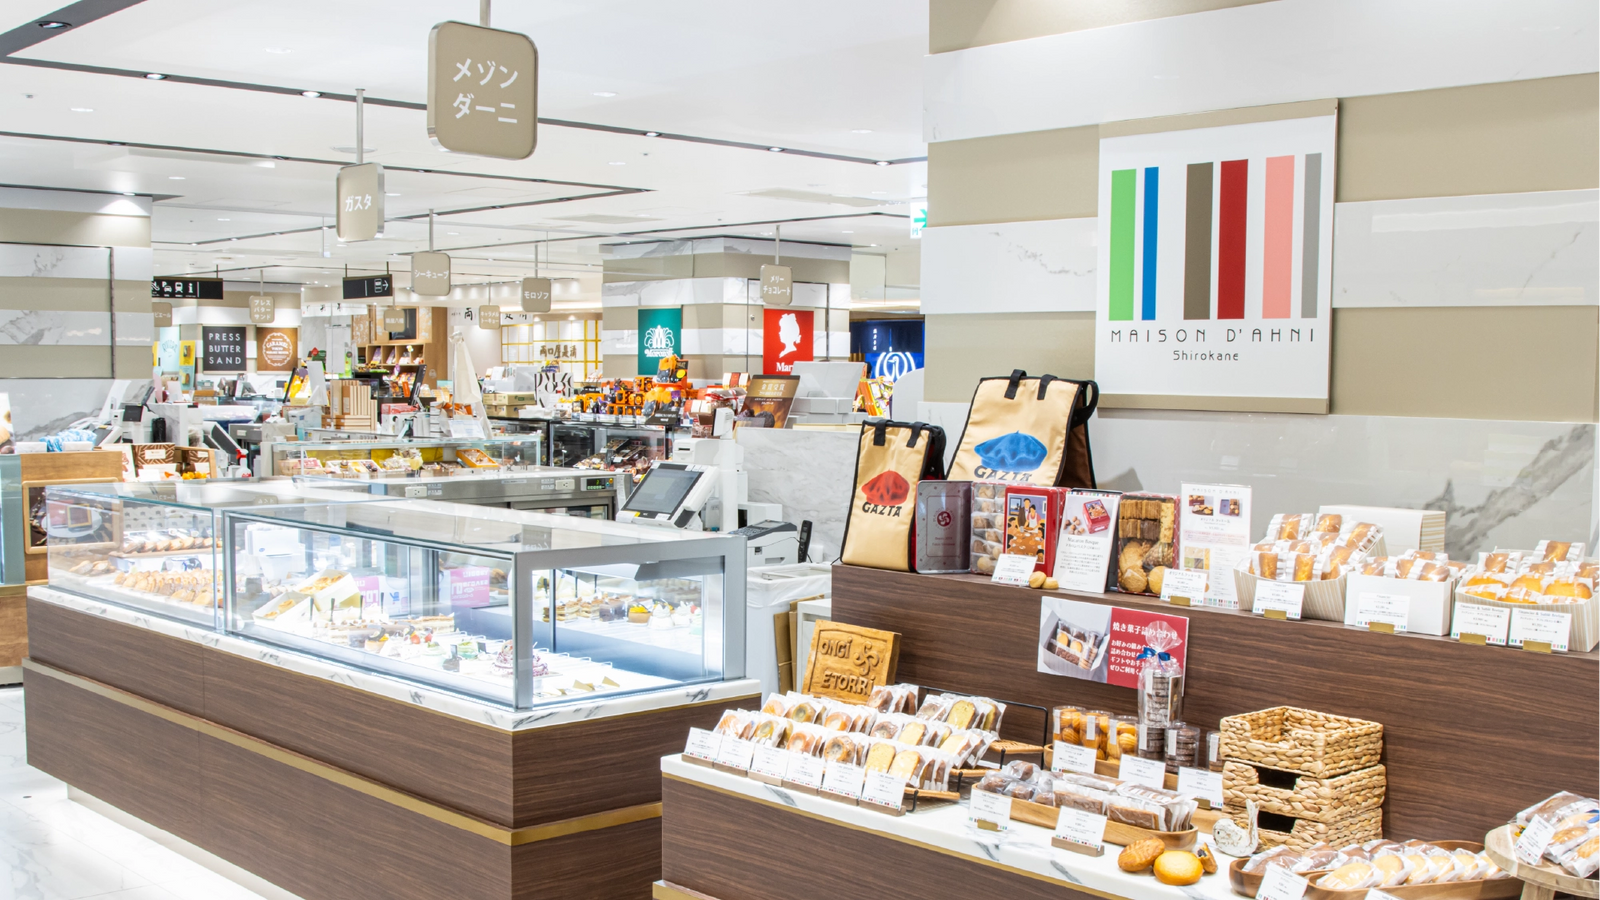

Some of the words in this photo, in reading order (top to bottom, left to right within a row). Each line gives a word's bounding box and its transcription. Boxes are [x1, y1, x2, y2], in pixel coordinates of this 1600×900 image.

[452, 57, 519, 89] メゾン
[452, 92, 518, 124] ダーニ
[345, 193, 372, 212] ガスタ
[414, 269, 450, 279] シーキューブ
[770, 275, 785, 283] メリー
[523, 291, 549, 300] モロゾフ
[763, 286, 791, 296] チョコレート
[208, 333, 241, 341] PRESS
[1111, 329, 1206, 342] MAISON
[1226, 328, 1314, 342] D'AHNI
[208, 345, 241, 353] BUTTER
[1173, 350, 1239, 361] Shirokane
[208, 357, 242, 365] SAND
[776, 362, 794, 372] Mar
[862, 501, 902, 518] GAZTA
[1112, 621, 1178, 640] 焼き菓子詰め合わせ
